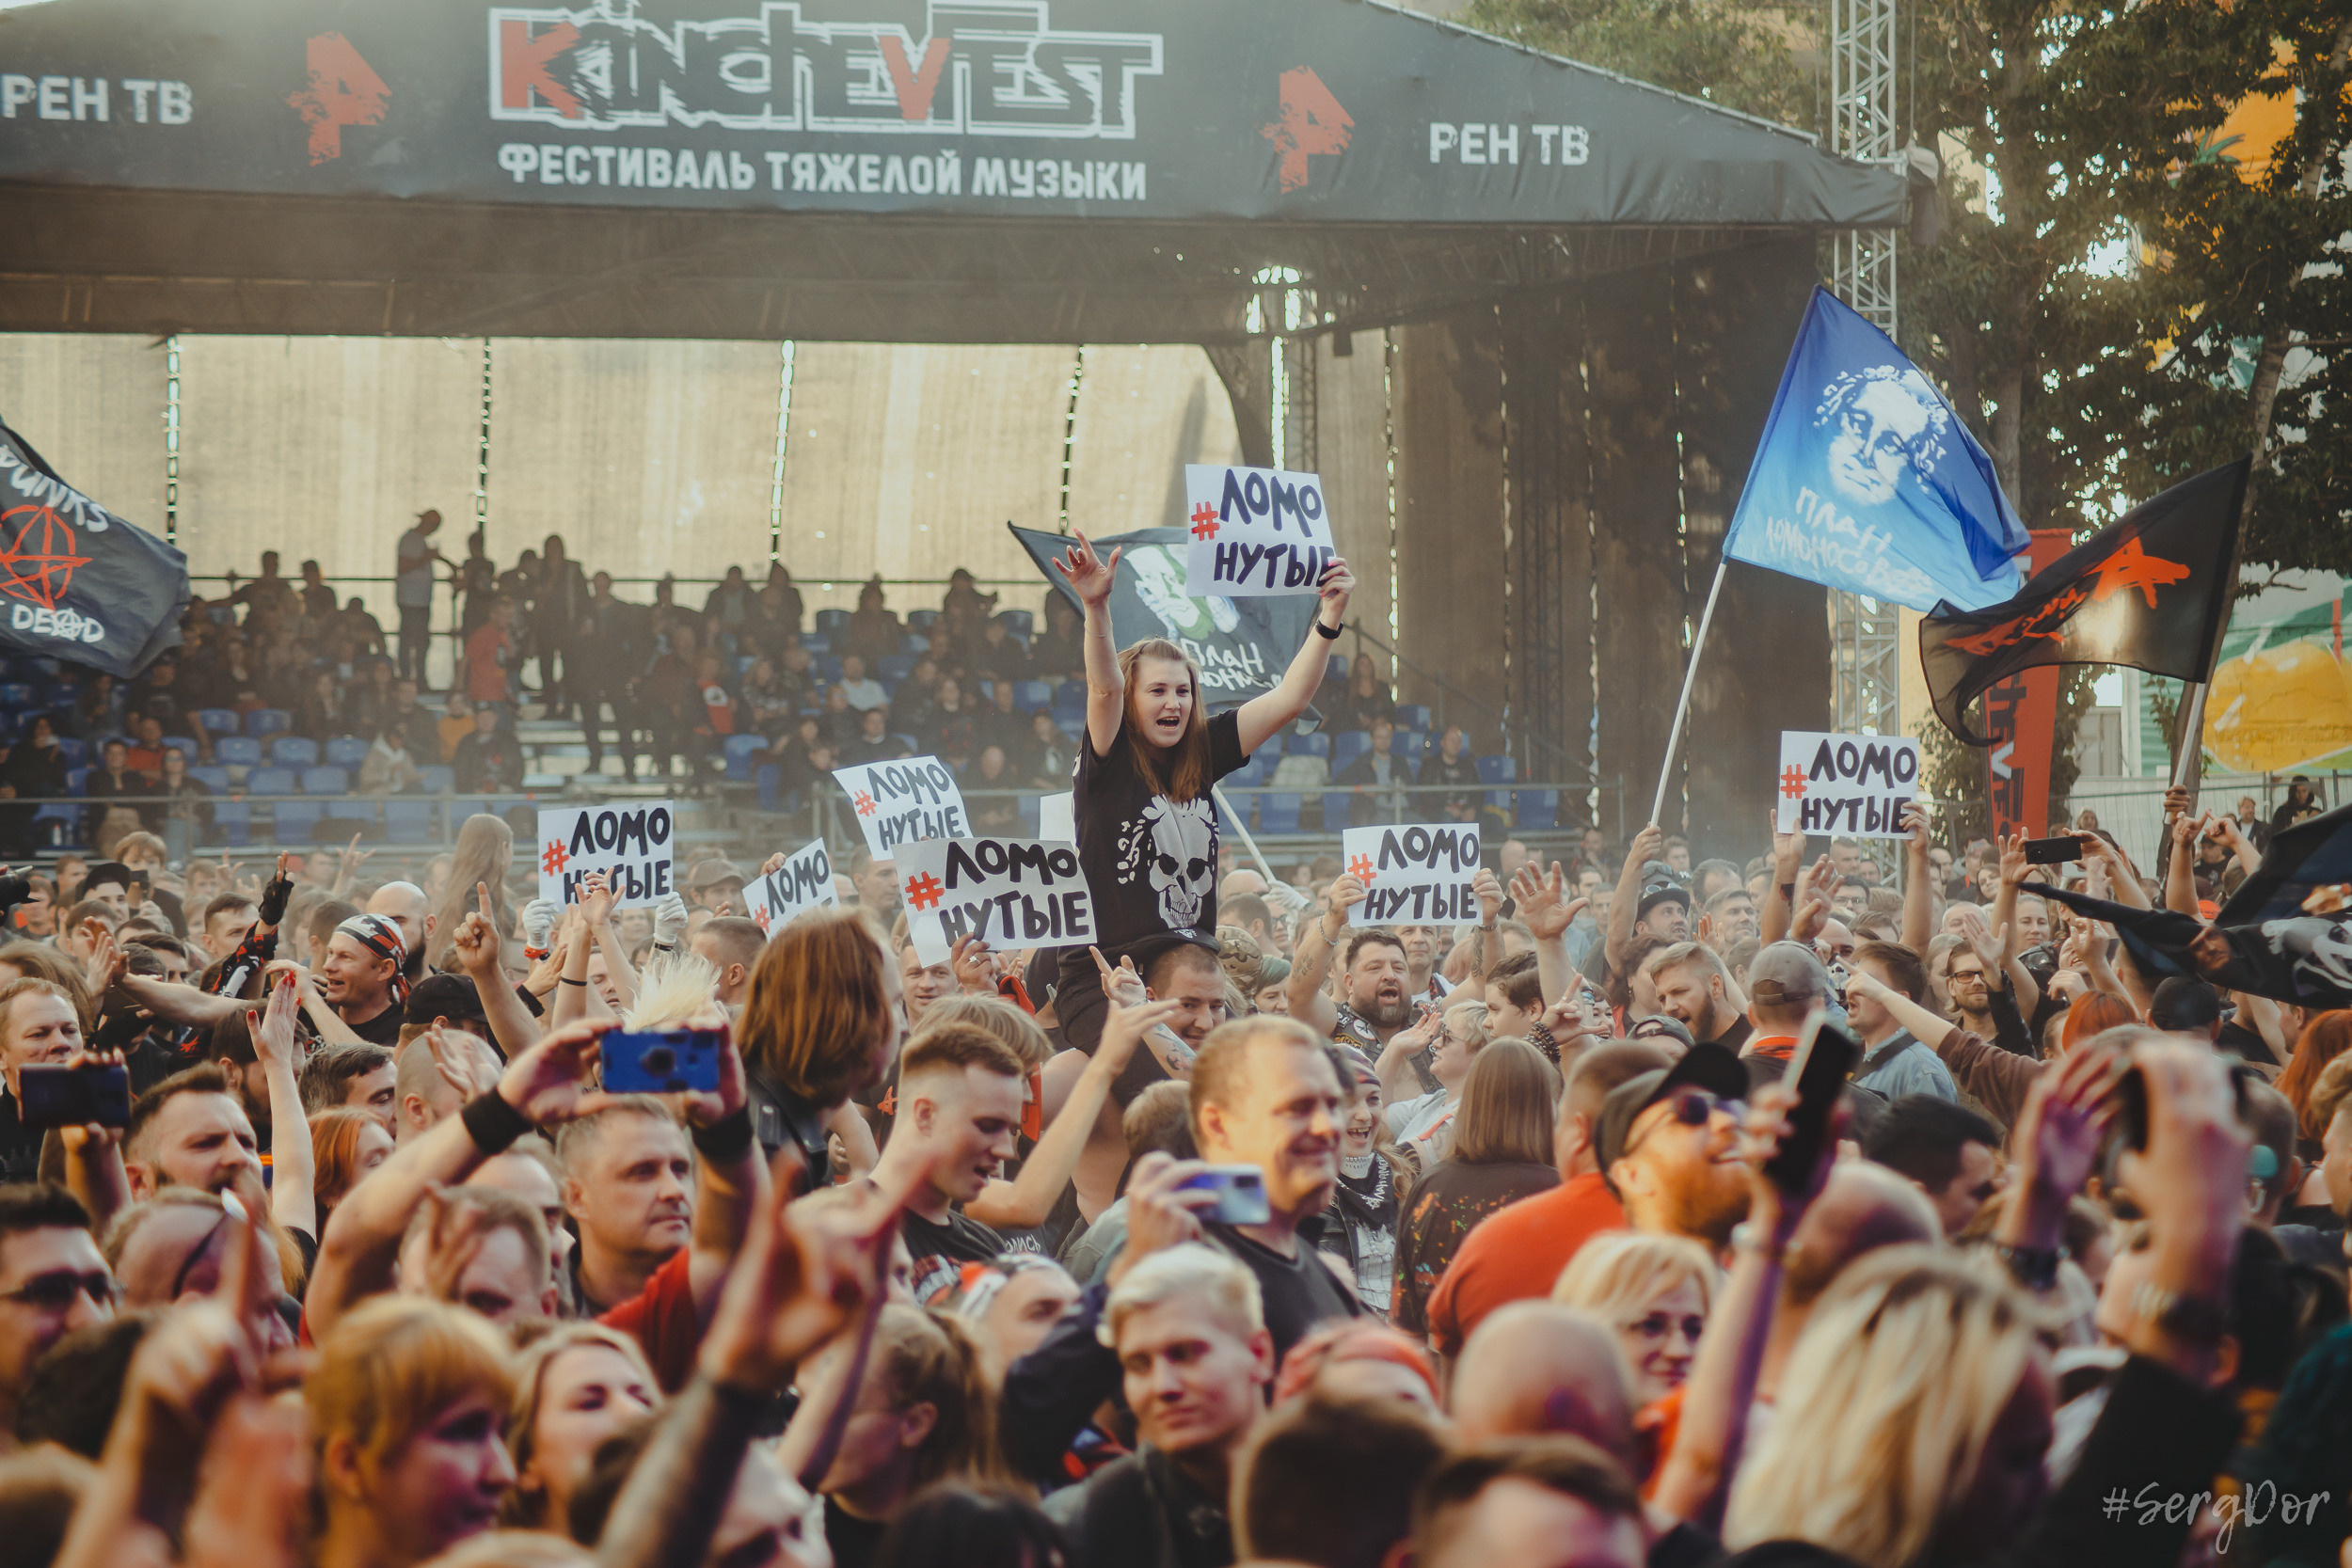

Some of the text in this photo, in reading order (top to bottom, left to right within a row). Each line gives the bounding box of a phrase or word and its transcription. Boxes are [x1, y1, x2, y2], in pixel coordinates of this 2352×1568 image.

[1, 74, 193, 126] РЕН ТВ
[1429, 122, 1590, 166] РЕН ТВ
[498, 143, 1148, 201] ФЕСТИВАЛЬ ТЯЖЕЛОЙ МУЗЫКИ
[878, 805, 965, 851] НУТЫЕ
[939, 890, 1090, 948] НУТЫЕ
[1364, 883, 1478, 920] НУТЫЕ
